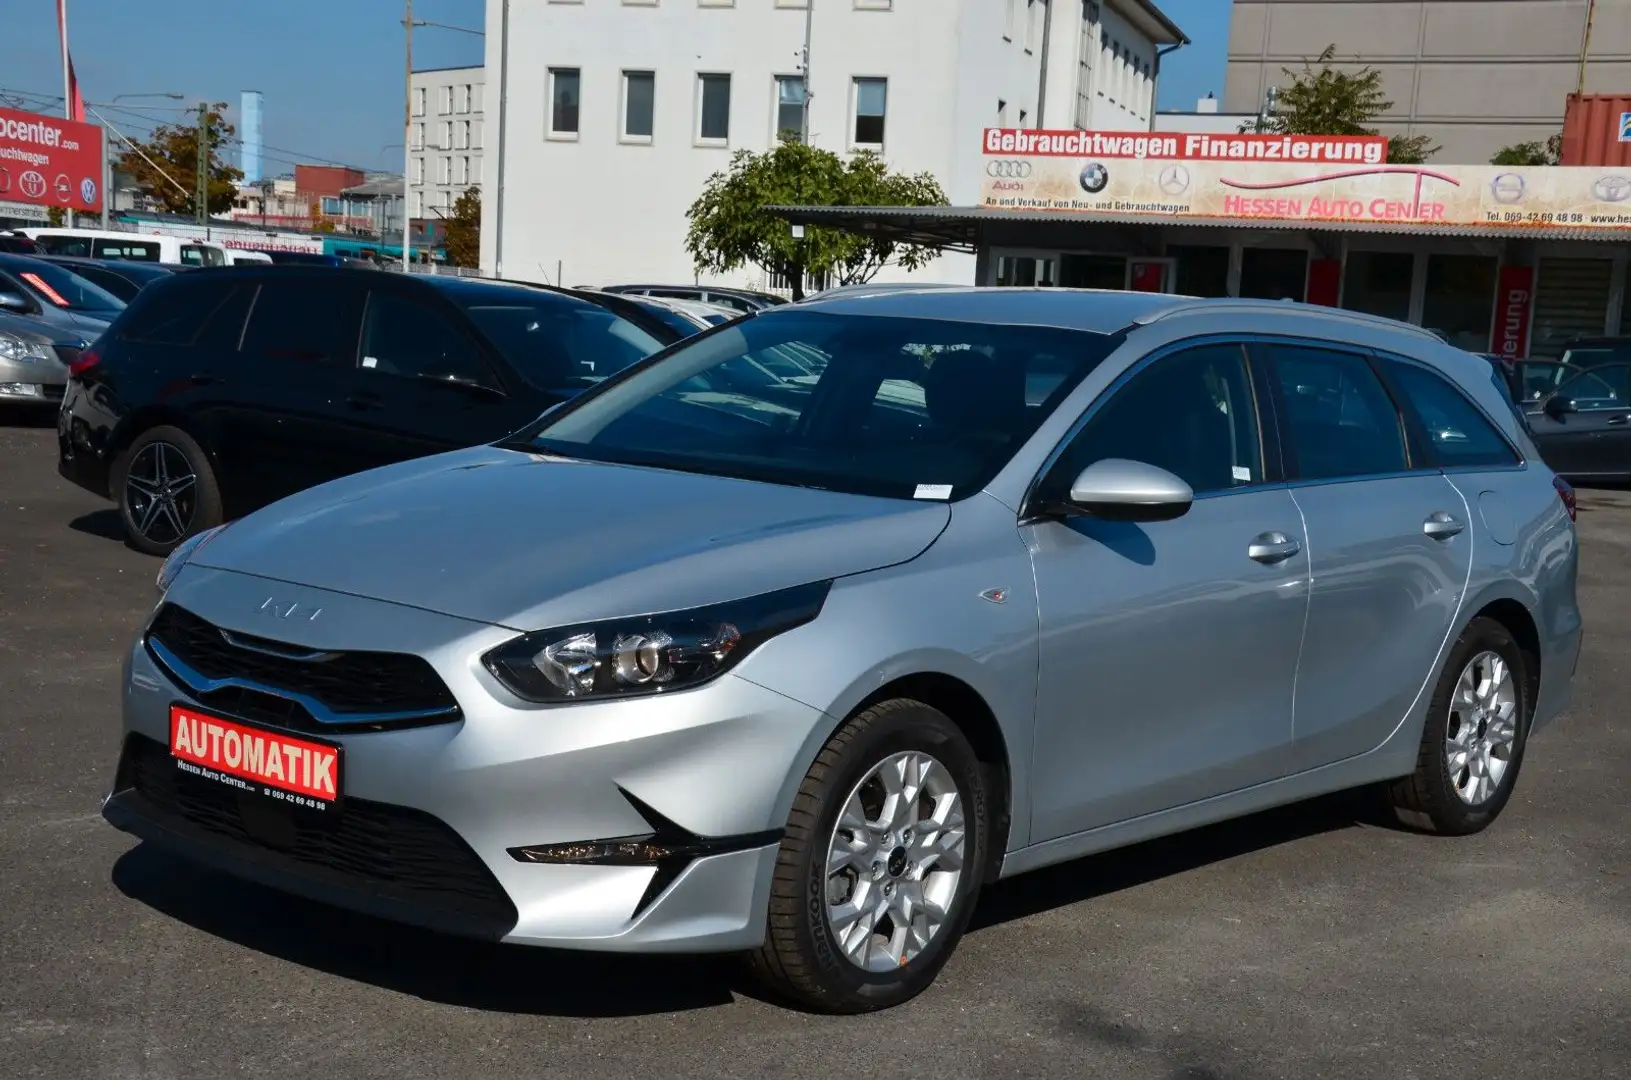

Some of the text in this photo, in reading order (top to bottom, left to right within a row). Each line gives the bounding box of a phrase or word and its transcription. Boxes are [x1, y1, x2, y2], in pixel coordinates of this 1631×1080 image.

[987, 129, 1382, 163] Gebrauchtwagen Finanzierung
[986, 197, 997, 205] An
[999, 198, 1015, 206] und
[1018, 199, 1051, 207] Verkauf
[1096, 202, 1112, 210] und
[1115, 202, 1190, 213] Gebrauchtwagen
[1307, 196, 1363, 218] AUTO
[1487, 212, 1501, 220] Tel.
[1541, 213, 1553, 222] 69
[1556, 213, 1568, 222] 48
[1571, 213, 1583, 222] 98
[175, 715, 335, 794] AUTOMATIK
[272, 790, 285, 800] 069
[286, 794, 295, 803] 42
[295, 796, 305, 805] 69
[306, 799, 315, 808] 48
[316, 801, 326, 811] 98
